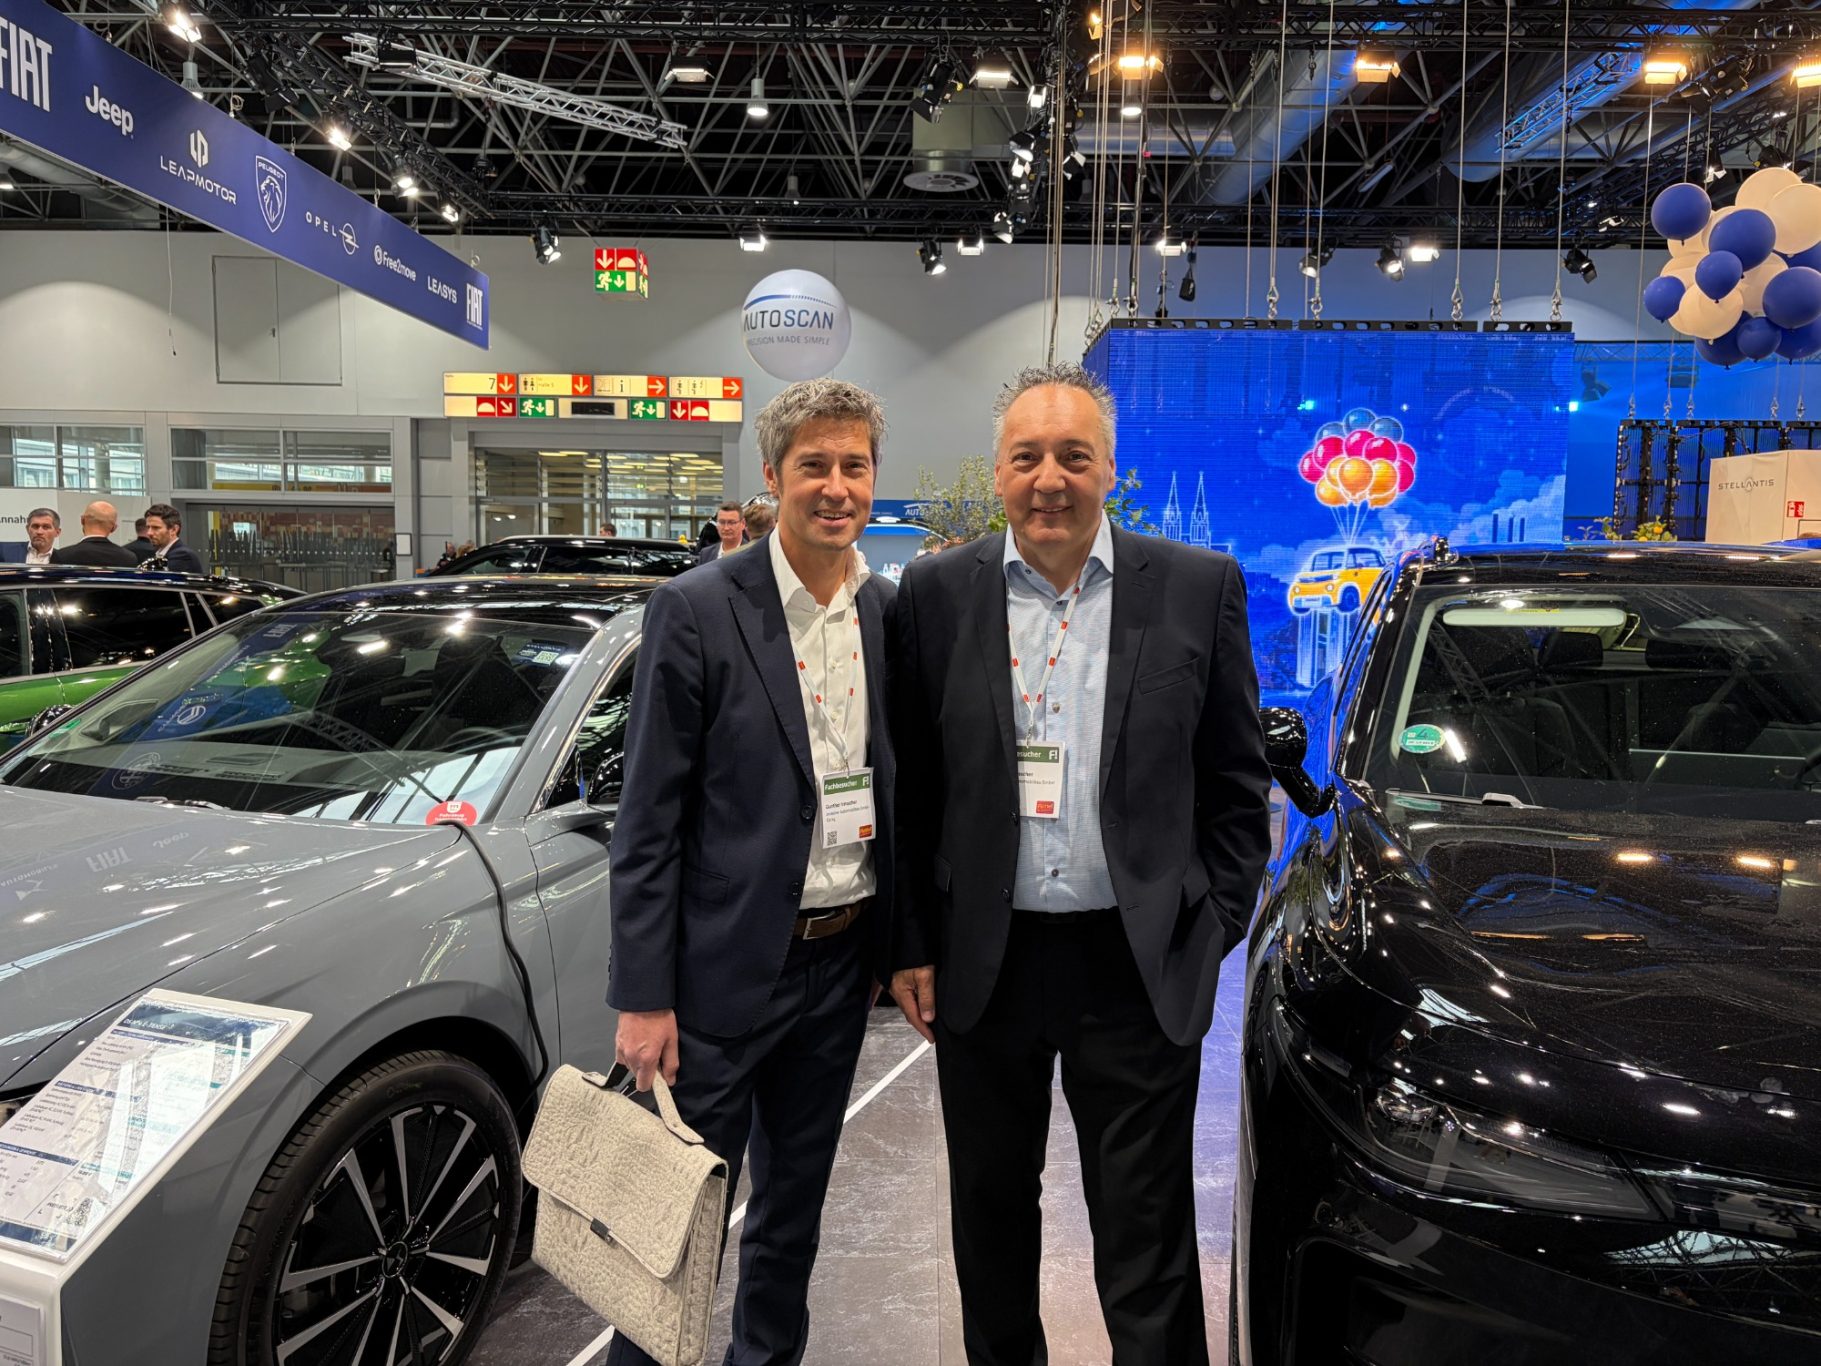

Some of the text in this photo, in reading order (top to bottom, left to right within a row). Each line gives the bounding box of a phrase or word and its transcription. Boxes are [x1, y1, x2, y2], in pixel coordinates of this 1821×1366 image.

[0, 15, 53, 112] FIAT
[85, 84, 134, 136] Jeep
[160, 154, 237, 205] LEAPMOTOR
[258, 161, 285, 180] PEUGEOT
[305, 211, 337, 237] OPEL
[383, 250, 416, 282] Free2move
[427, 275, 457, 304] LEASYS
[466, 283, 483, 326] FIAT
[744, 309, 834, 331] AUTOSCAN
[777, 336, 801, 344] MADE
[488, 377, 496, 390] 7
[1718, 478, 1775, 490] STELLANTIS
[0, 514, 27, 524] nnah
